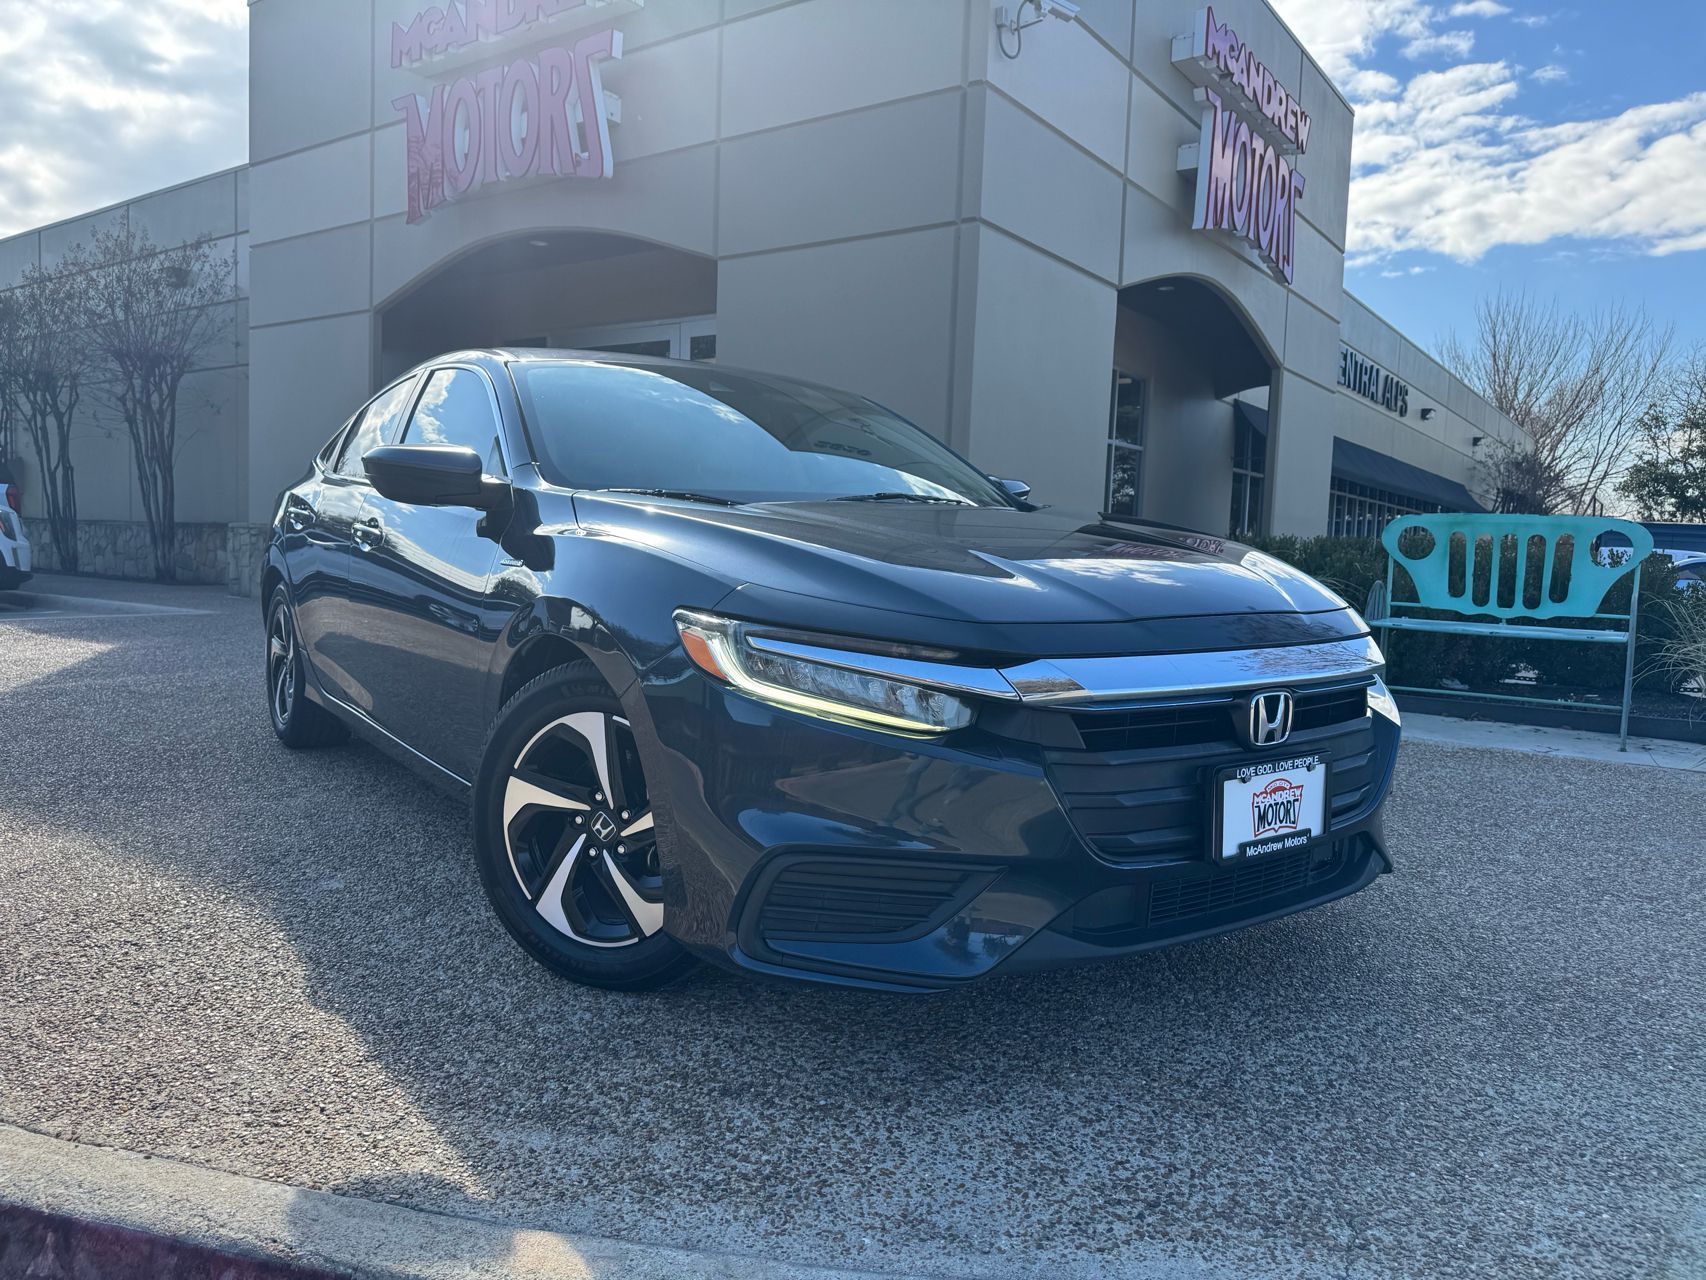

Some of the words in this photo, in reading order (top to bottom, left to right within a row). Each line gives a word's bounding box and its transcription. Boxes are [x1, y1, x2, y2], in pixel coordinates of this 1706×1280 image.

[391, 29, 616, 224] MOTORS
[1204, 87, 1306, 285] MOTORS
[1236, 767, 1256, 779] LOVE
[1275, 761, 1294, 772] LOVE
[1254, 798, 1299, 833] MOTORS
[1246, 842, 1284, 858] McAndrew
